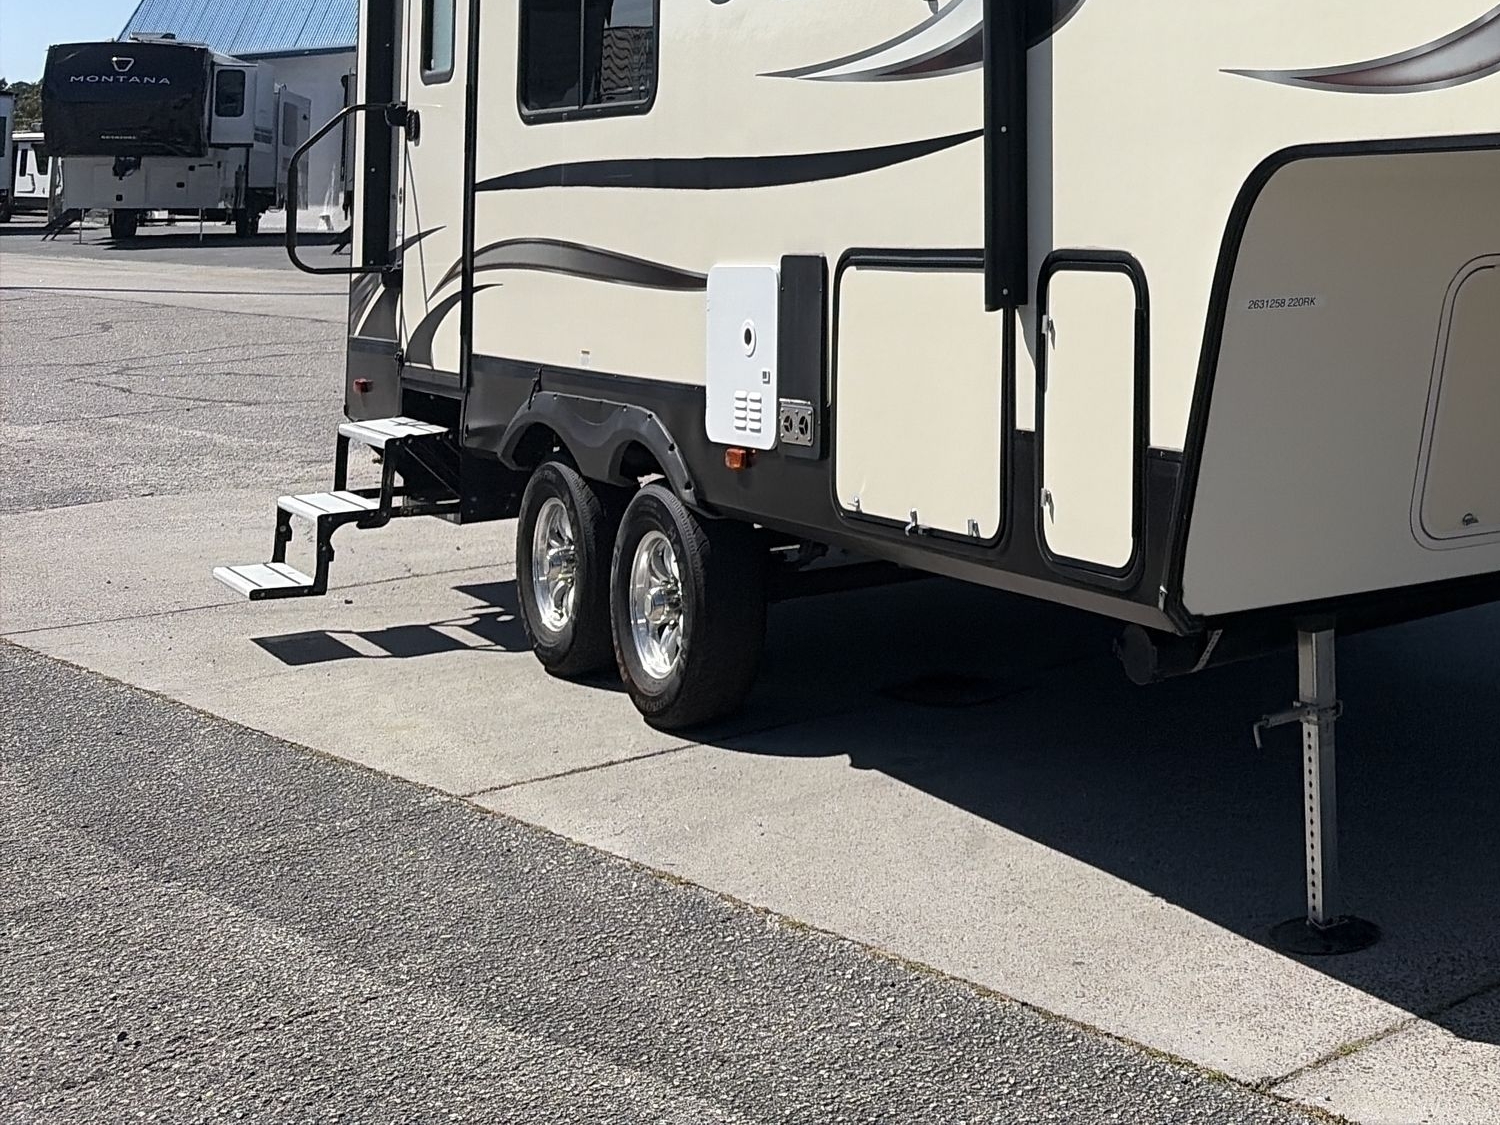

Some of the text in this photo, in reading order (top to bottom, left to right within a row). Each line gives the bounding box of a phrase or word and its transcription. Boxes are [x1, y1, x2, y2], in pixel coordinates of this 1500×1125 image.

[70, 75, 170, 85] MONTANA
[1248, 296, 1316, 309] 2631258 220RK
